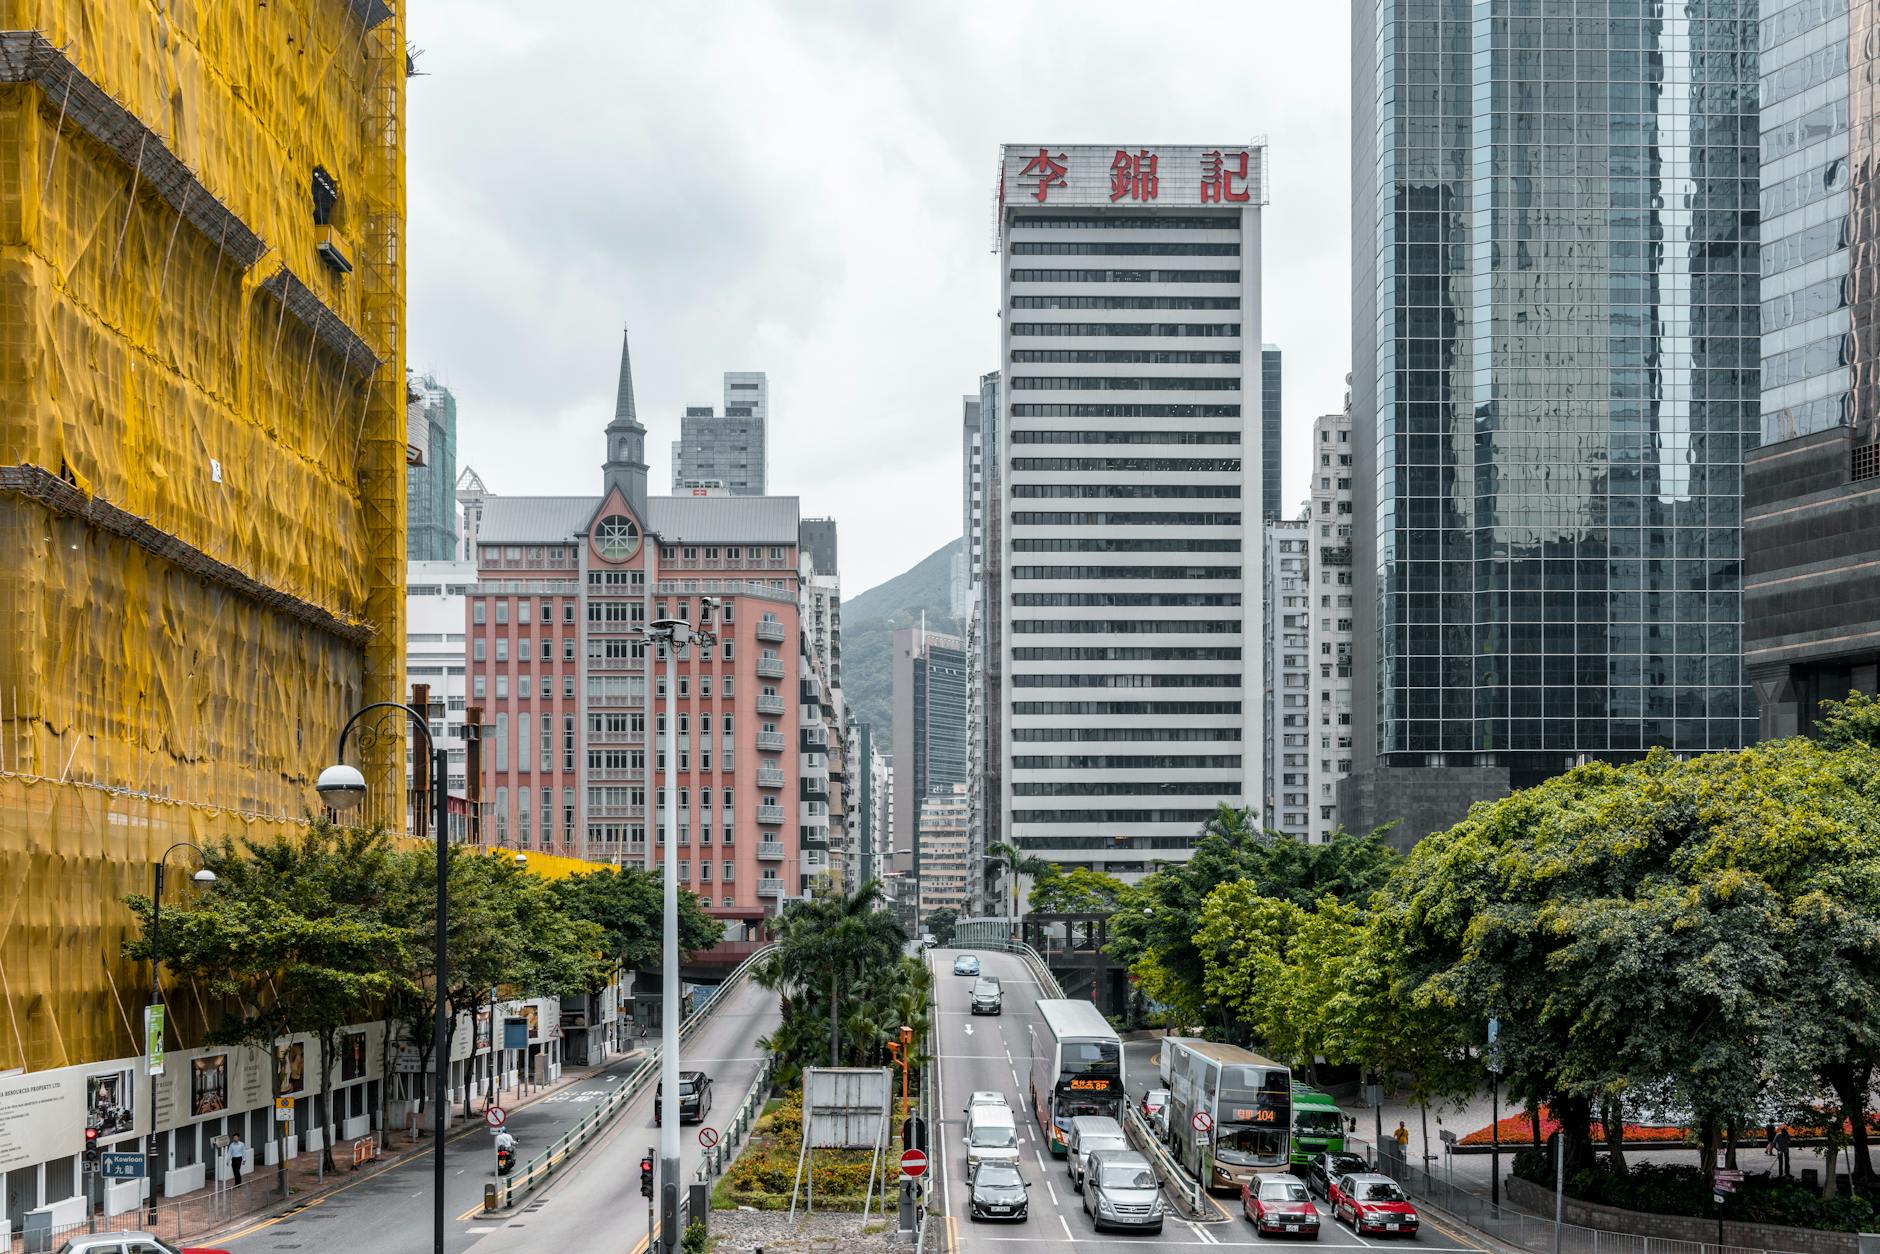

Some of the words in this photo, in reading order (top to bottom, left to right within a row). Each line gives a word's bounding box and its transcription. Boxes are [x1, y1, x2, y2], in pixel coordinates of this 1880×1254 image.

[1017, 148, 1250, 203] 李錦記
[1256, 1110, 1274, 1121] 104
[114, 1165, 134, 1175] 九龍
